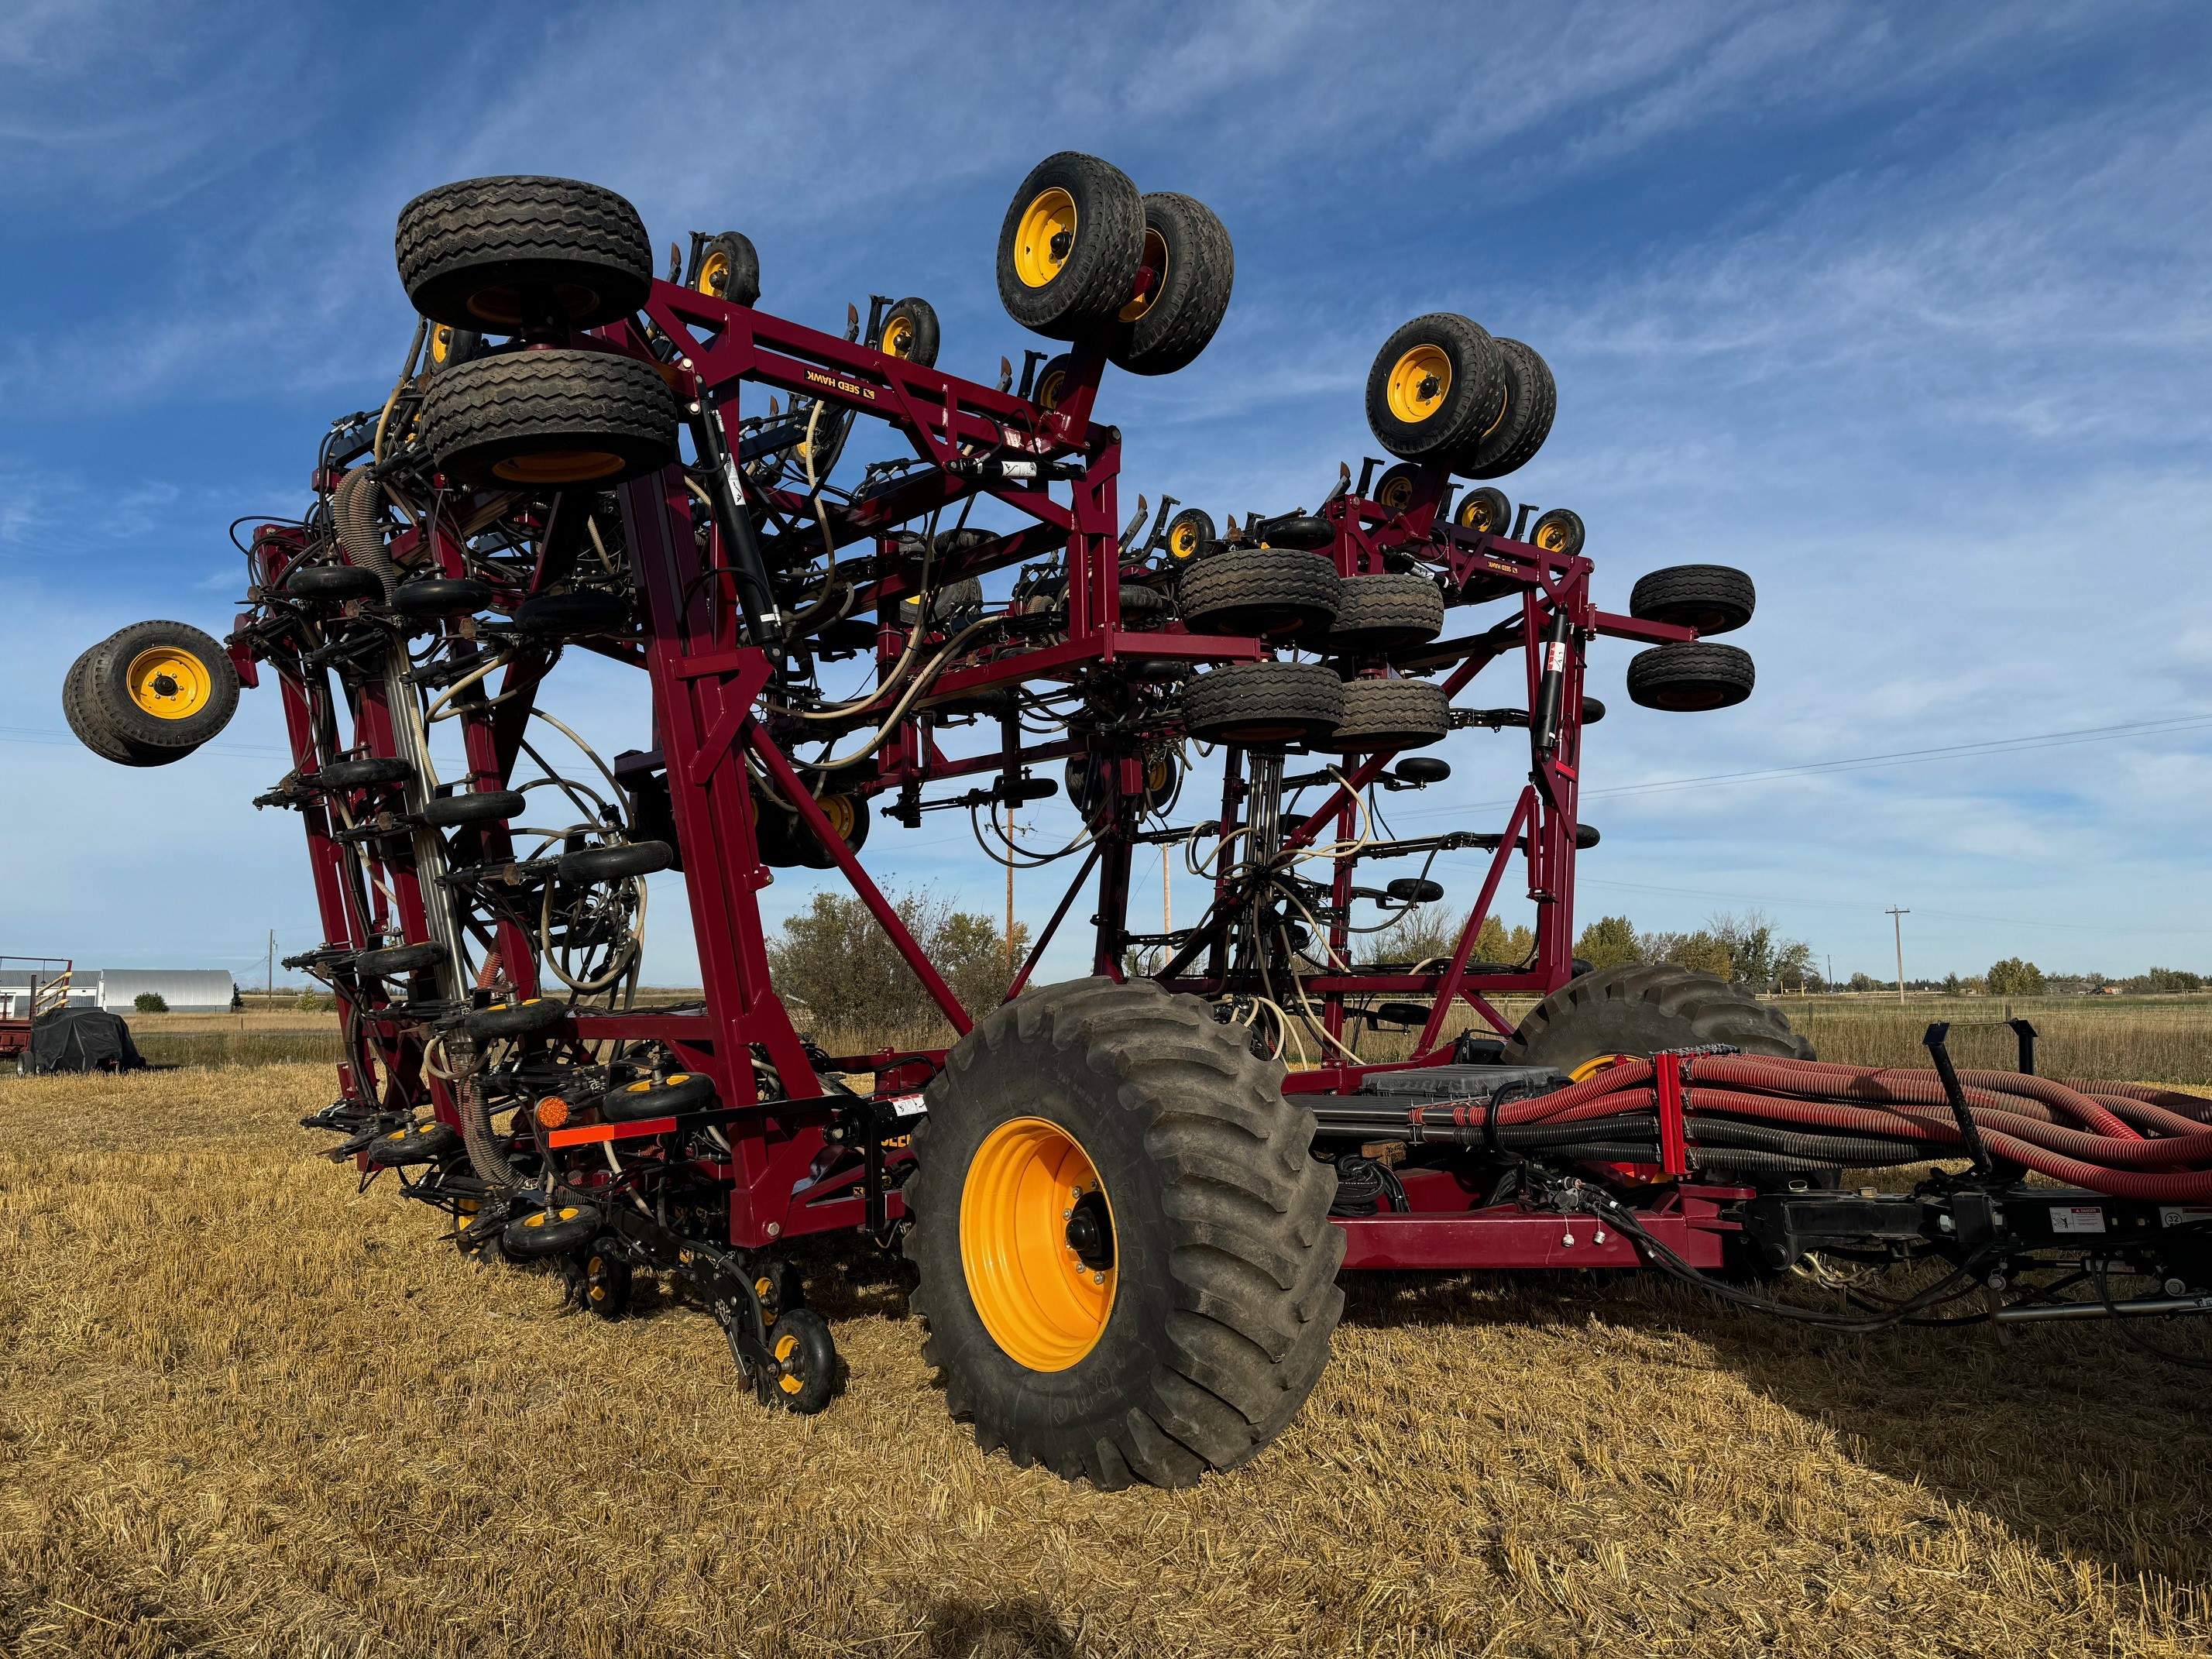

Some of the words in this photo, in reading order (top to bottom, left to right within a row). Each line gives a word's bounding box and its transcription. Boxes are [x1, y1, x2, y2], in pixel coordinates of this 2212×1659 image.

[807, 370, 836, 387] HAWK
[838, 381, 860, 394] SEED
[1488, 561, 1501, 569] HAWK
